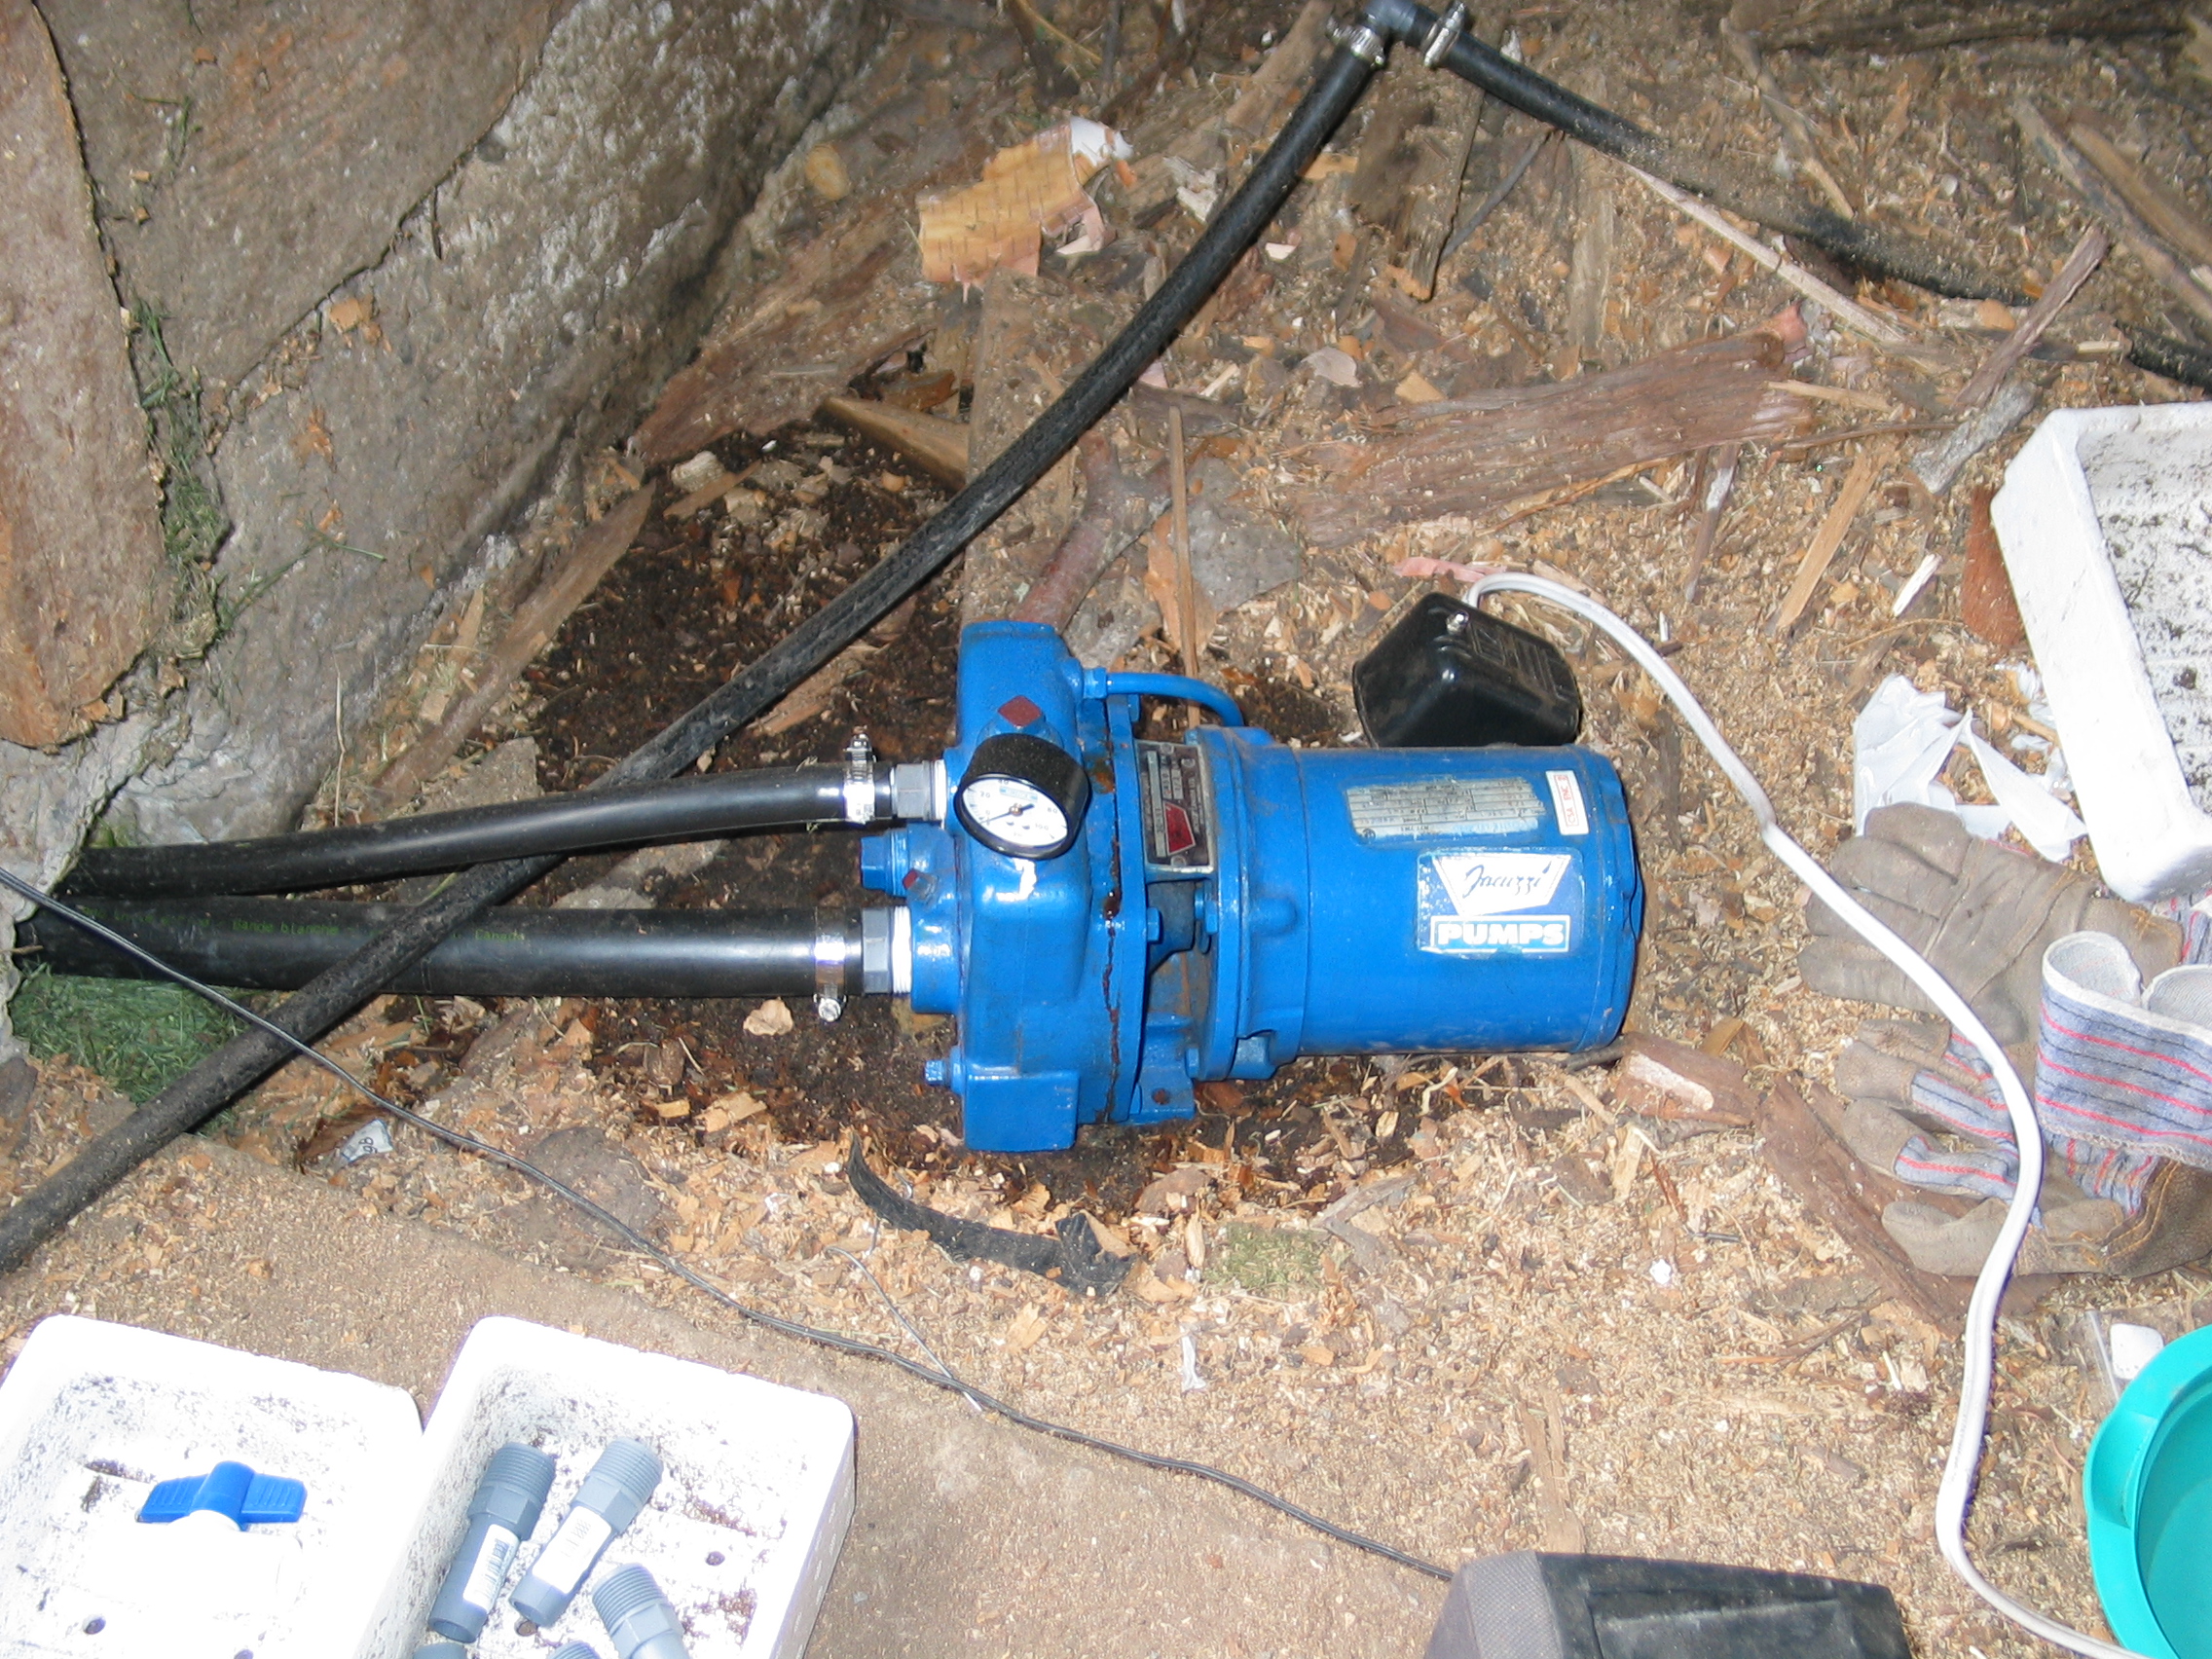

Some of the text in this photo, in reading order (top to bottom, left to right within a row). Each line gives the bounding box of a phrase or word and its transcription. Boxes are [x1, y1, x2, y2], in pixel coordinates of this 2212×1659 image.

[1462, 862, 1553, 900] Jacuzzi
[233, 919, 275, 933] Bande
[280, 922, 340, 936] blanche
[1437, 922, 1565, 946] PUMPS
